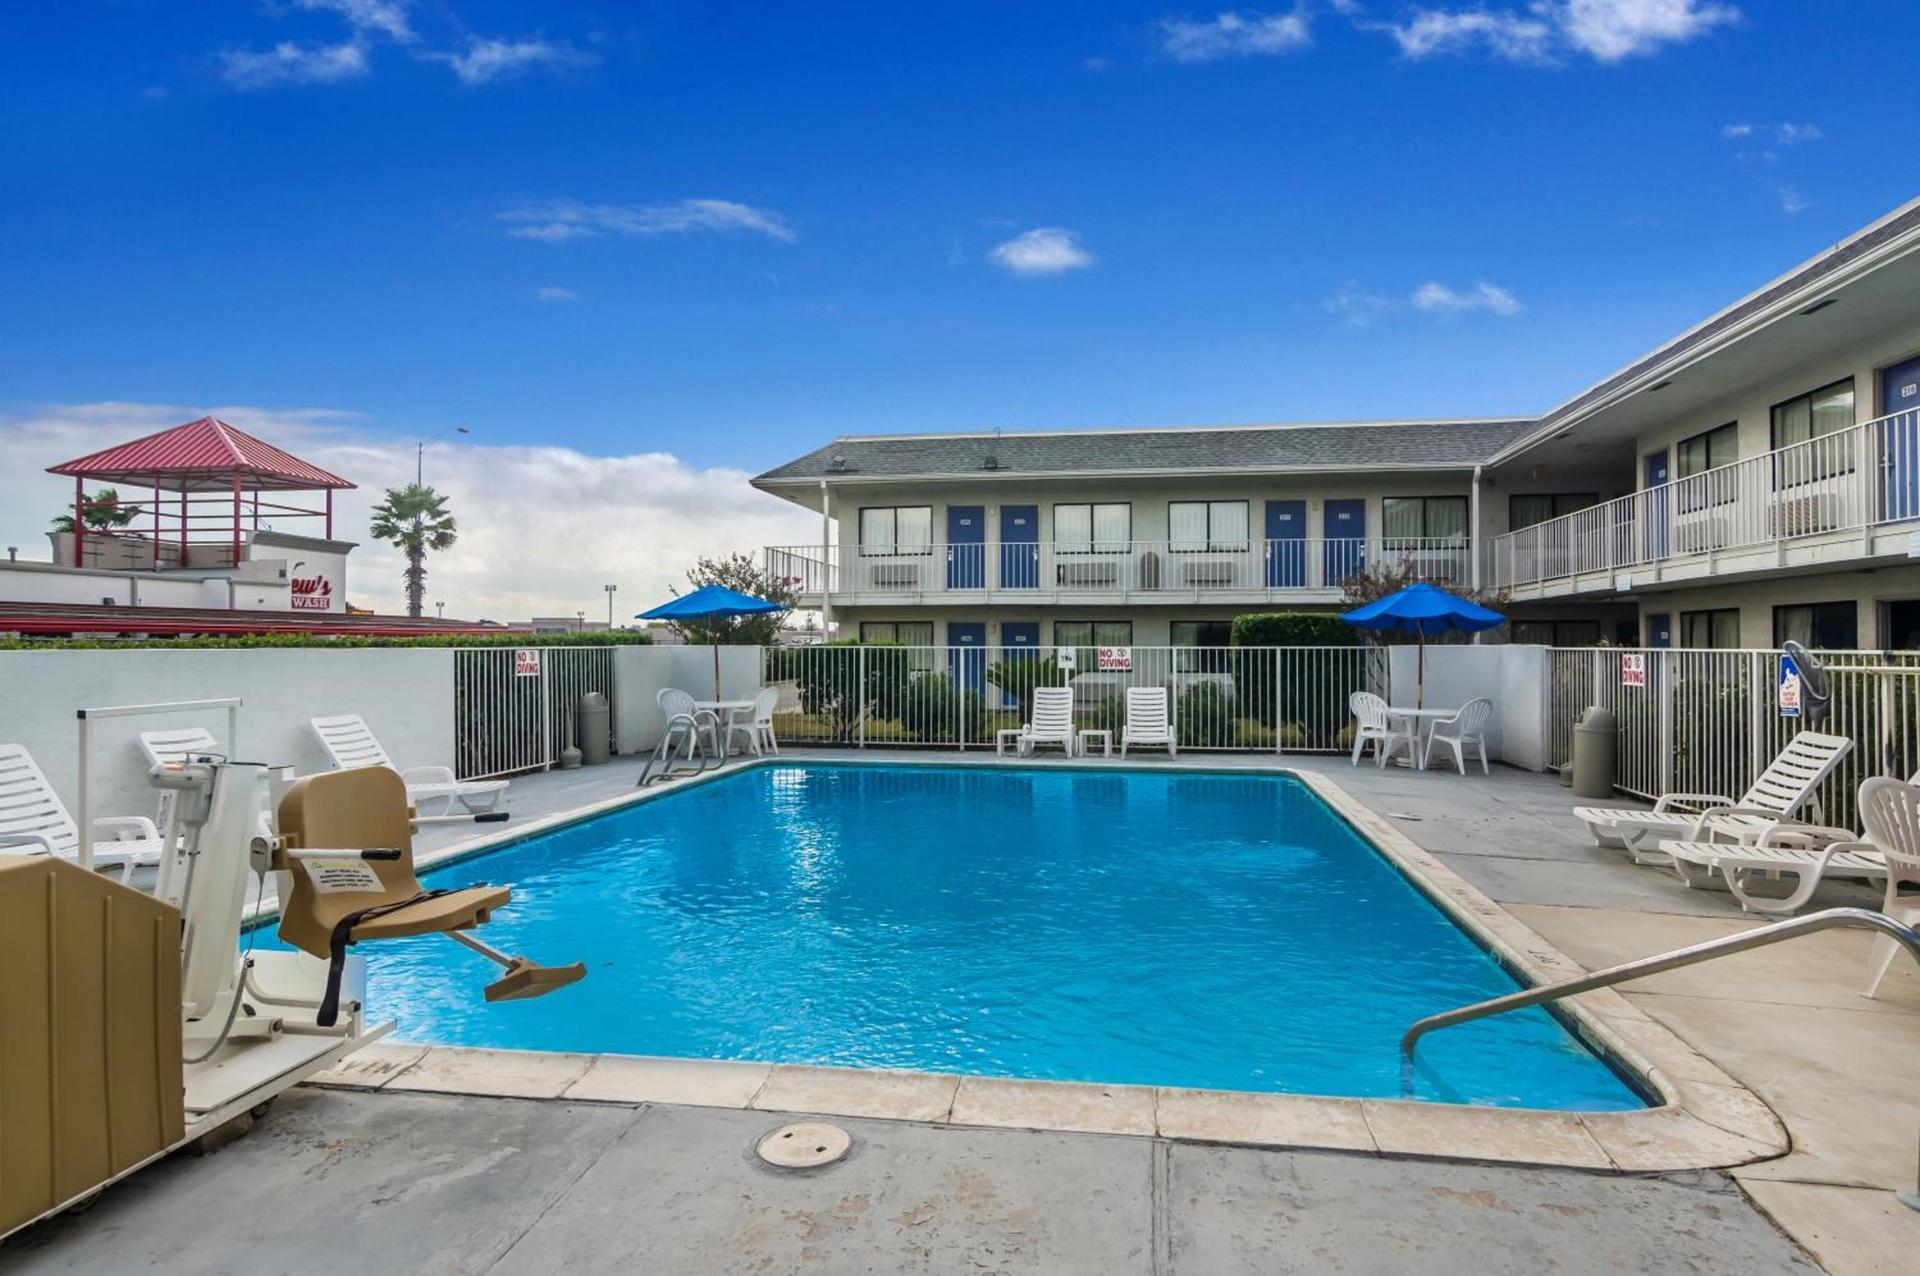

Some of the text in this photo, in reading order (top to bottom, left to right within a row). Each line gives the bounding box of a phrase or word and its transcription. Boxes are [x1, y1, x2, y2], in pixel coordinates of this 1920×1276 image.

[292, 597, 328, 608] WASH
[517, 652, 526, 661] NO
[1100, 649, 1112, 658] NO
[517, 663, 538, 673] DIVING
[1100, 659, 1130, 667] DIVING
[1624, 657, 1632, 669] NO
[1624, 670, 1643, 683] DIVING
